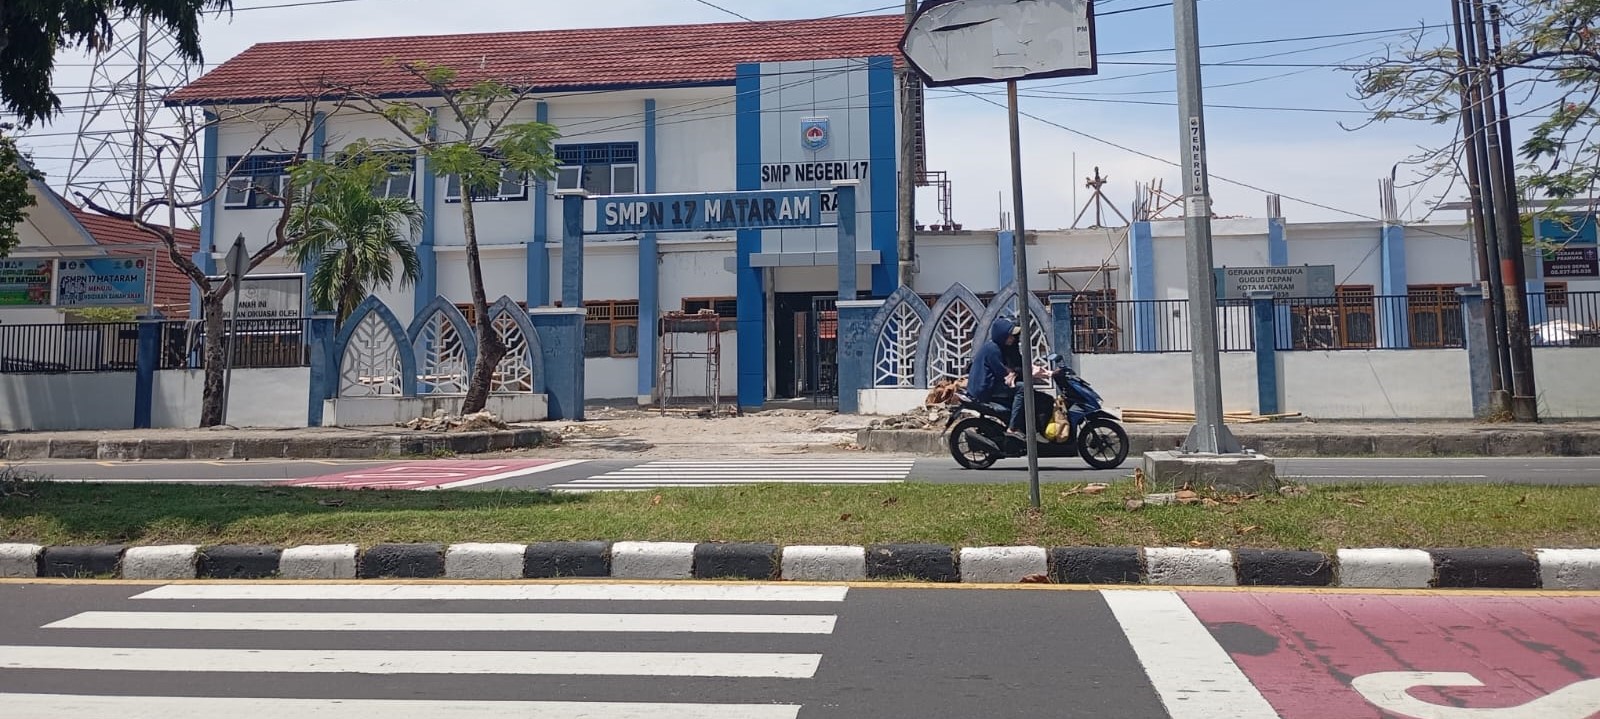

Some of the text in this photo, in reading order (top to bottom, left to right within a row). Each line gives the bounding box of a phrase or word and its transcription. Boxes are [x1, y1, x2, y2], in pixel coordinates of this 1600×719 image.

[762, 162, 868, 182] SMP NEGERI 17
[605, 196, 811, 225] SMPN 17 MATARAM
[65, 275, 87, 283] SMPN
[96, 274, 138, 282] MATARAM
[258, 300, 267, 308] INI
[247, 310, 277, 318] DIKUASAI
